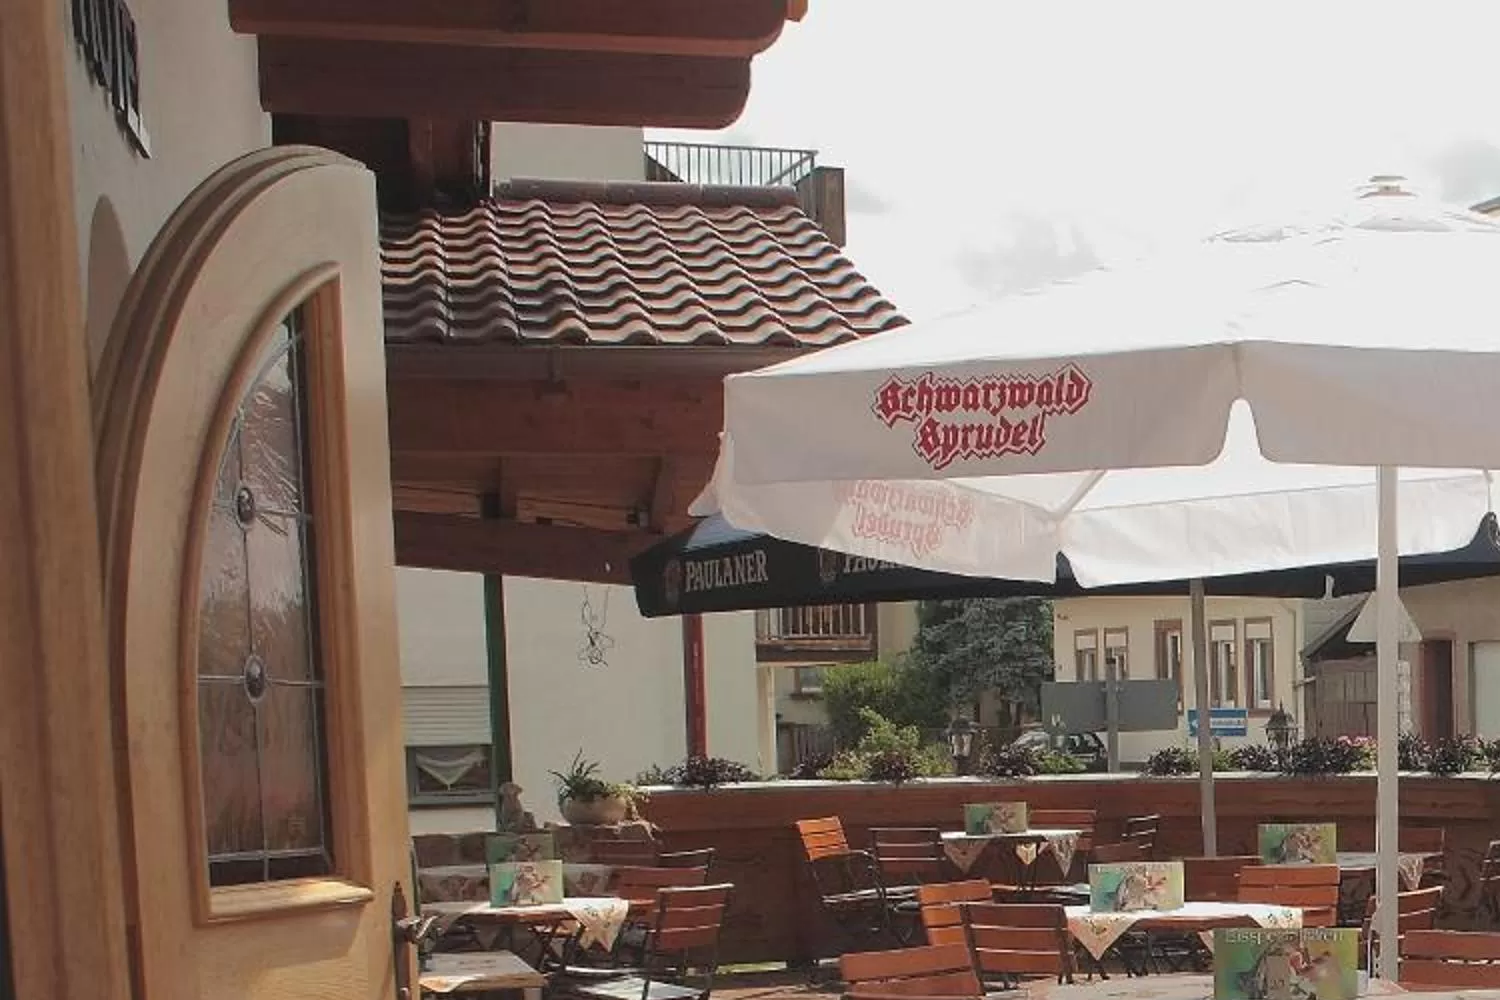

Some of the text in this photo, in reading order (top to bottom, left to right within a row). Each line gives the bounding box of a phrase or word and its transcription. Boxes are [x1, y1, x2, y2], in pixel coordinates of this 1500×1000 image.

[875, 363, 1092, 424] Schwarzwald
[916, 417, 1046, 468] Sprudel
[684, 549, 769, 592] PAULANER
